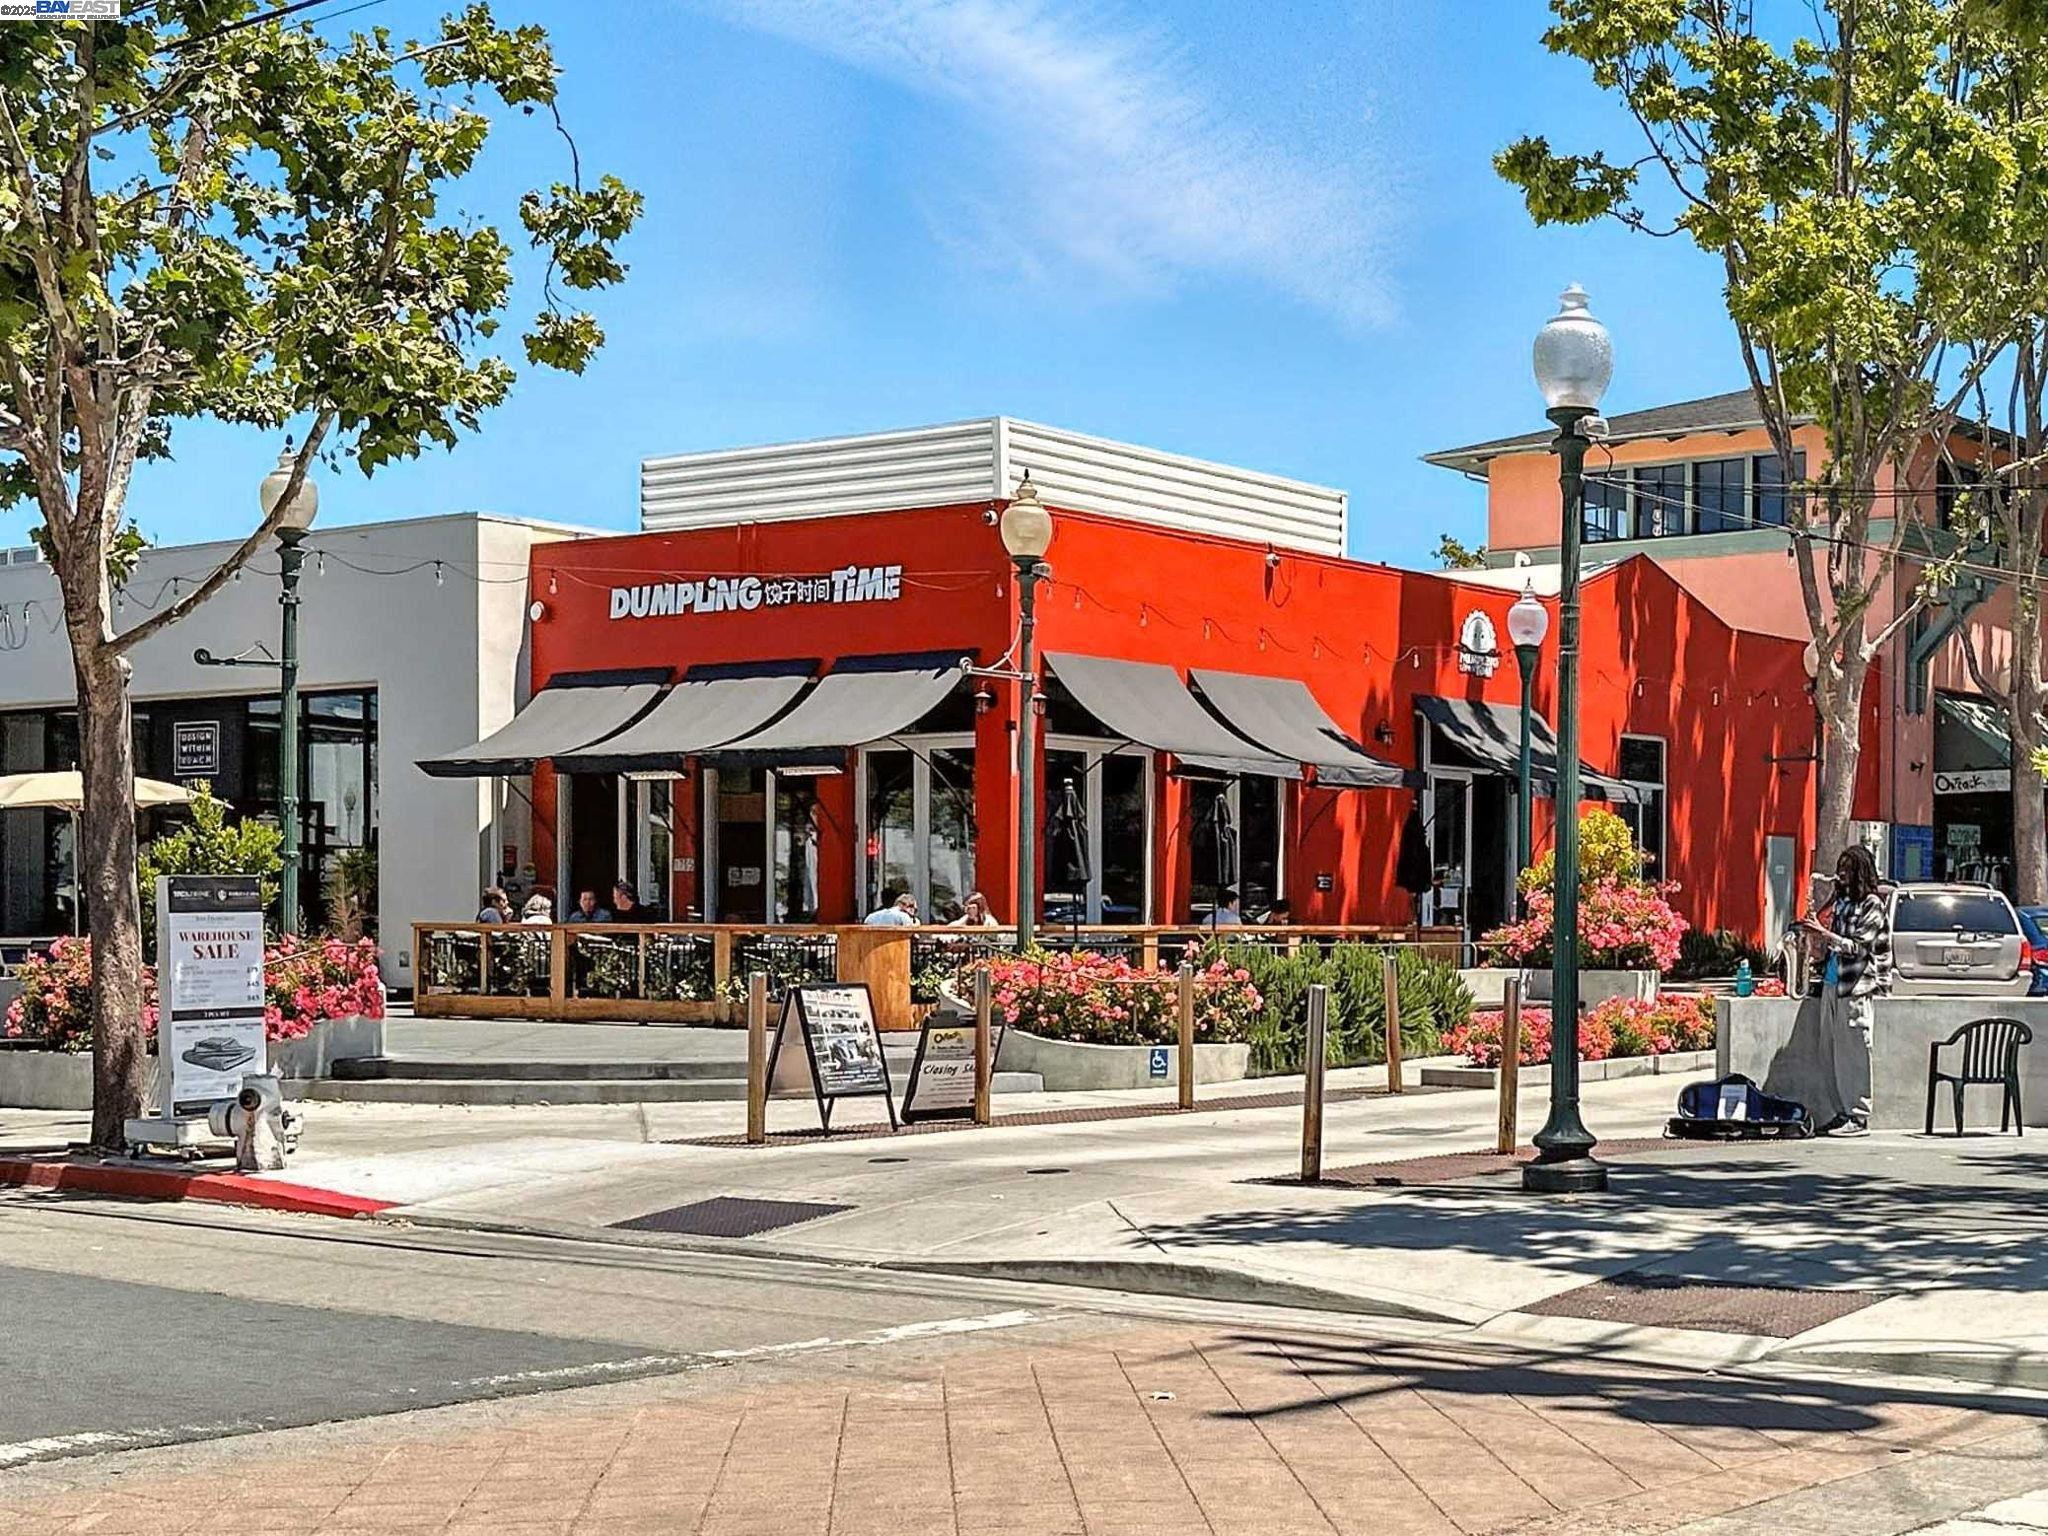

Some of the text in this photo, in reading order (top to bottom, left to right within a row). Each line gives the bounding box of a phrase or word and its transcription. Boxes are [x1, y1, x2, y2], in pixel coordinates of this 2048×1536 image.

[181, 732, 212, 741] DESIGN
[181, 744, 212, 752] WITHIN
[178, 930, 255, 942] WAREHOUSE
[193, 943, 240, 960] SALE
[923, 1064, 958, 1077] Closing
